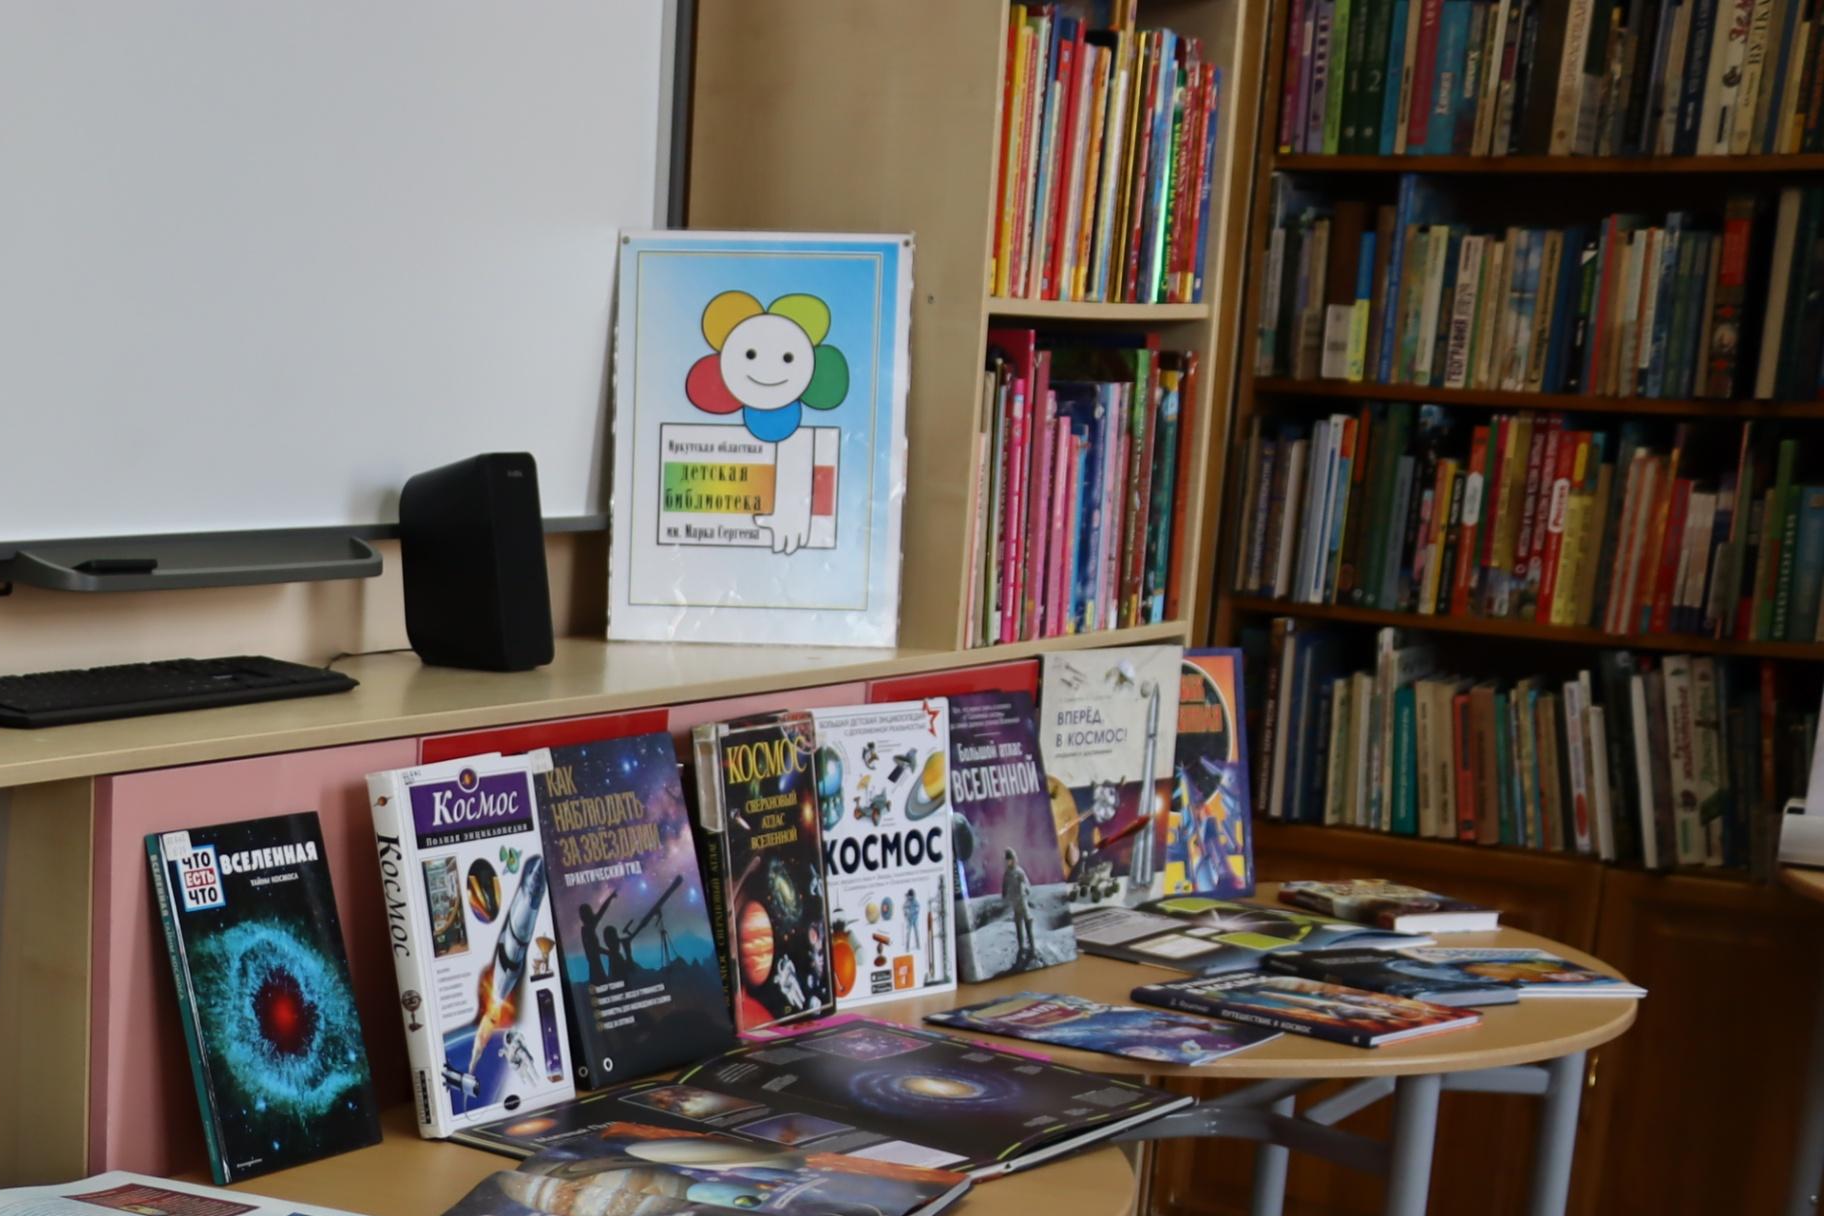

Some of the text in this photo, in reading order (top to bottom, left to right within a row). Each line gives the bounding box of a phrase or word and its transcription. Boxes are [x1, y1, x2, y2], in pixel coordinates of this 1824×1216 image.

[680, 463, 749, 483] детская
[664, 487, 762, 513] библиотека
[1056, 733, 1063, 748] В
[726, 735, 808, 785] КОСМОС
[544, 766, 578, 798] КАК
[951, 754, 1041, 804] ВСЕЛЕННОЙ
[432, 789, 520, 827] Космос
[552, 790, 645, 832] НАБЛЮДАТЬ
[182, 852, 211, 869] ЧТО
[219, 841, 318, 875] ВСЕЛЕННАЯ
[559, 822, 661, 868] ЗА ЗВЁЗДАМИ
[826, 827, 944, 876] КОСМОС
[186, 869, 215, 887] ЕСТЬ
[377, 832, 410, 958] Космос
[189, 887, 218, 905] ЧТО
